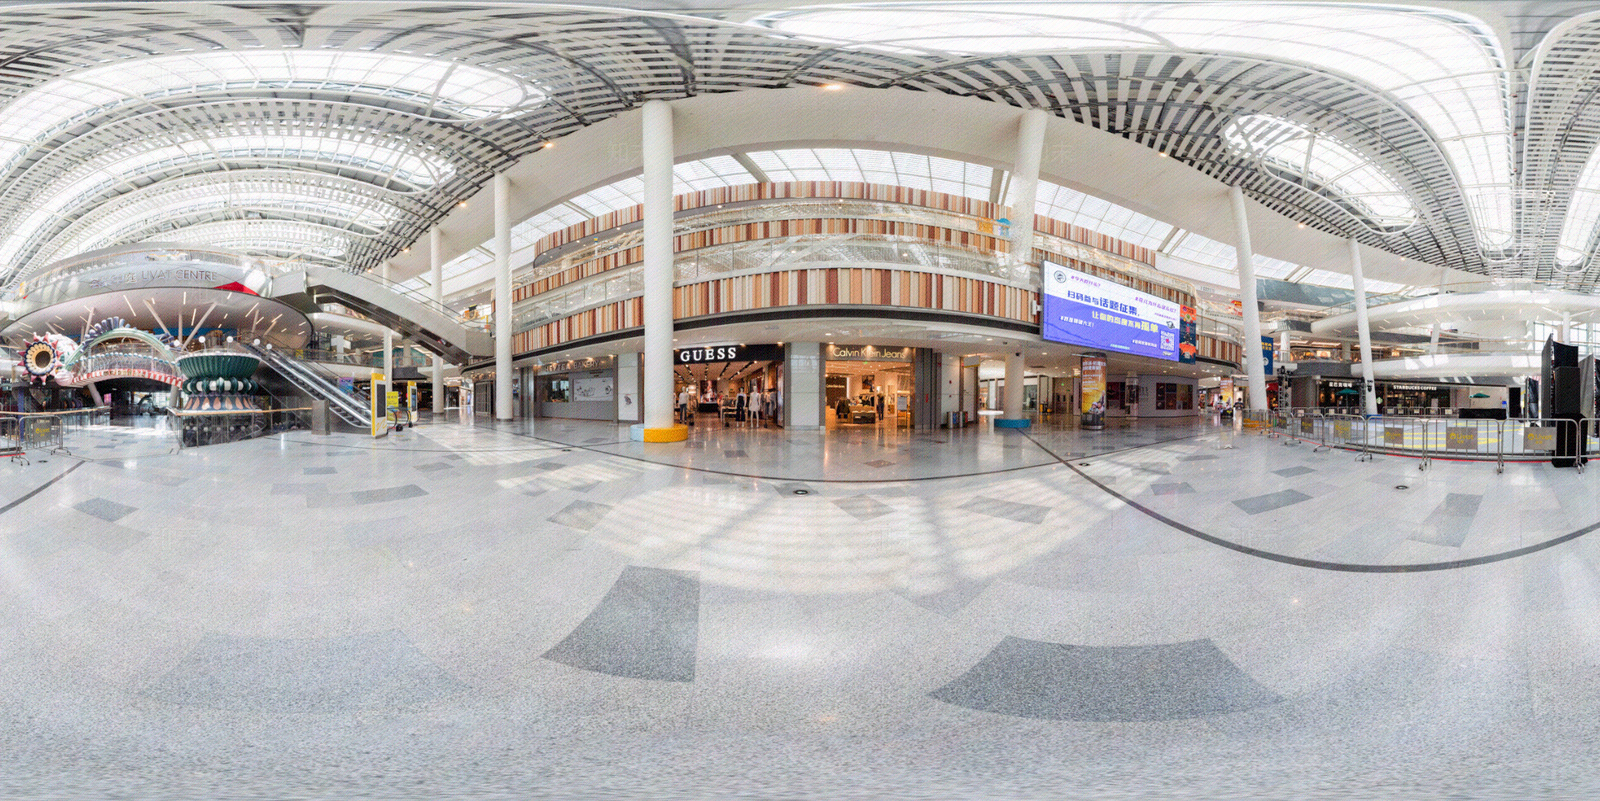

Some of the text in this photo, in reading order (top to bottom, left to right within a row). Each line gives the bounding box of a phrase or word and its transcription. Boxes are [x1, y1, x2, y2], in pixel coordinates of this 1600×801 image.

[175, 269, 217, 282] CENTRE
[680, 347, 737, 362] GUESS
[833, 347, 859, 357] Calvin
[882, 348, 906, 359] Jeans
